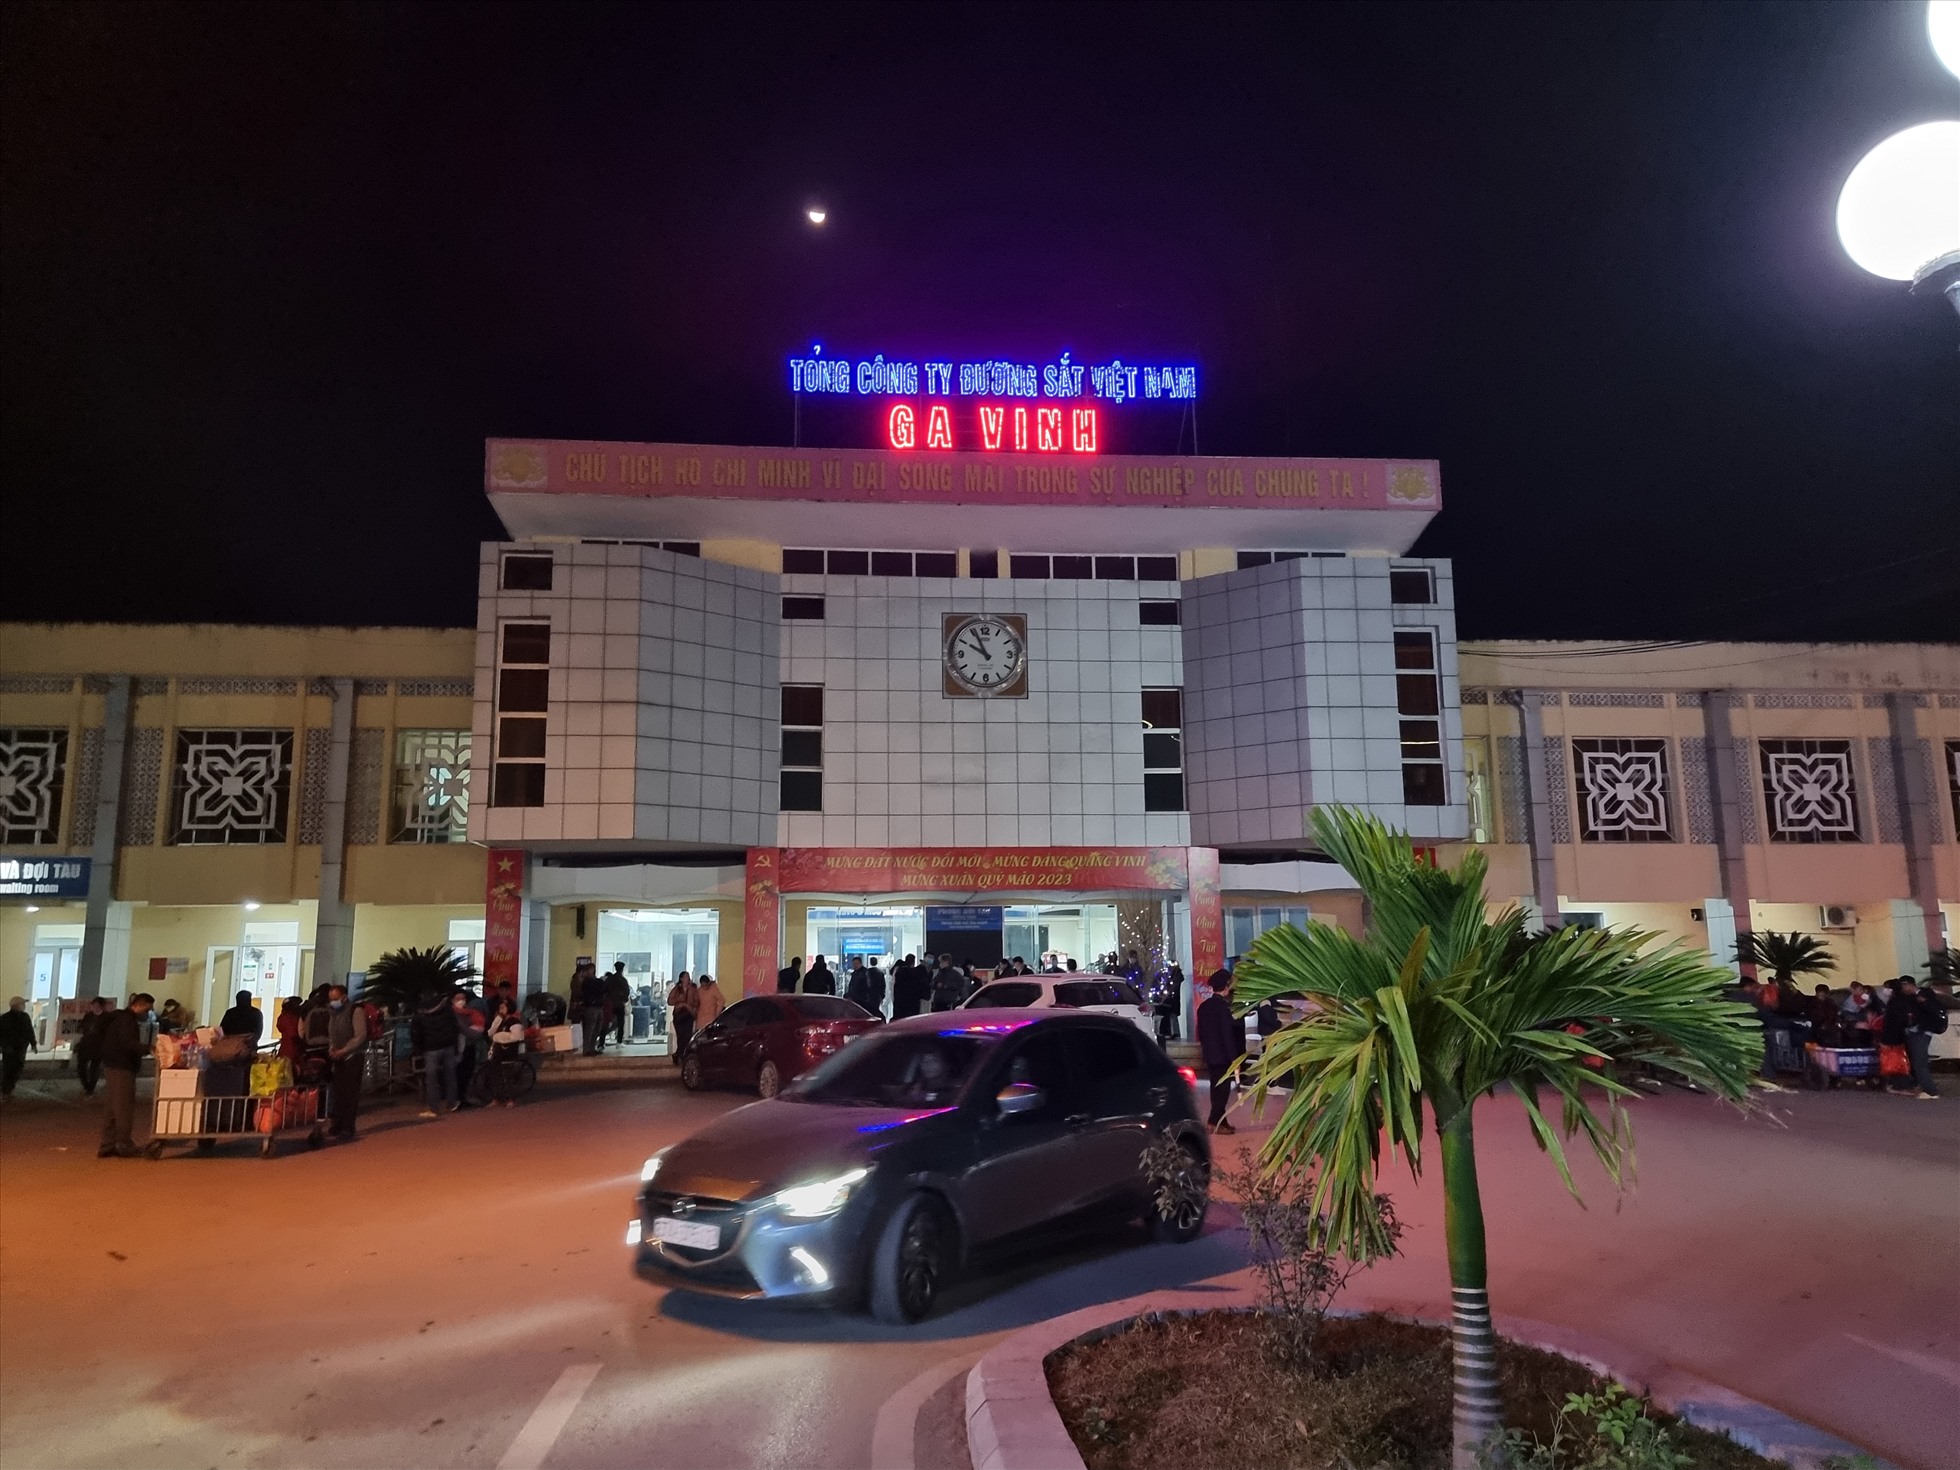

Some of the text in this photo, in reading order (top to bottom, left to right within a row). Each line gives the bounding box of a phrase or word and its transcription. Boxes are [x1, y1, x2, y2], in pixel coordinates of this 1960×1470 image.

[857, 354, 918, 394] CÔNG
[925, 363, 953, 395] TY
[1044, 352, 1084, 397] SẮT
[1090, 360, 1138, 403] VIỆT
[1144, 366, 1196, 399] NAM
[888, 404, 1097, 452] GA VINH
[619, 454, 664, 489] TỊCH
[758, 458, 811, 489] MINH
[1015, 465, 1078, 495] TRONG
[1126, 462, 1195, 501] NGHIỆP
[980, 627, 990, 635] 12
[958, 650, 965, 658] 9
[1006, 651, 1013, 659] 3
[982, 673, 989, 682] 6
[1115, 856, 1147, 868] VINH
[23, 861, 49, 881] ĐỢI
[1036, 873, 1073, 886] 2023
[34, 884, 59, 894] room
[40, 973, 47, 982] 5
